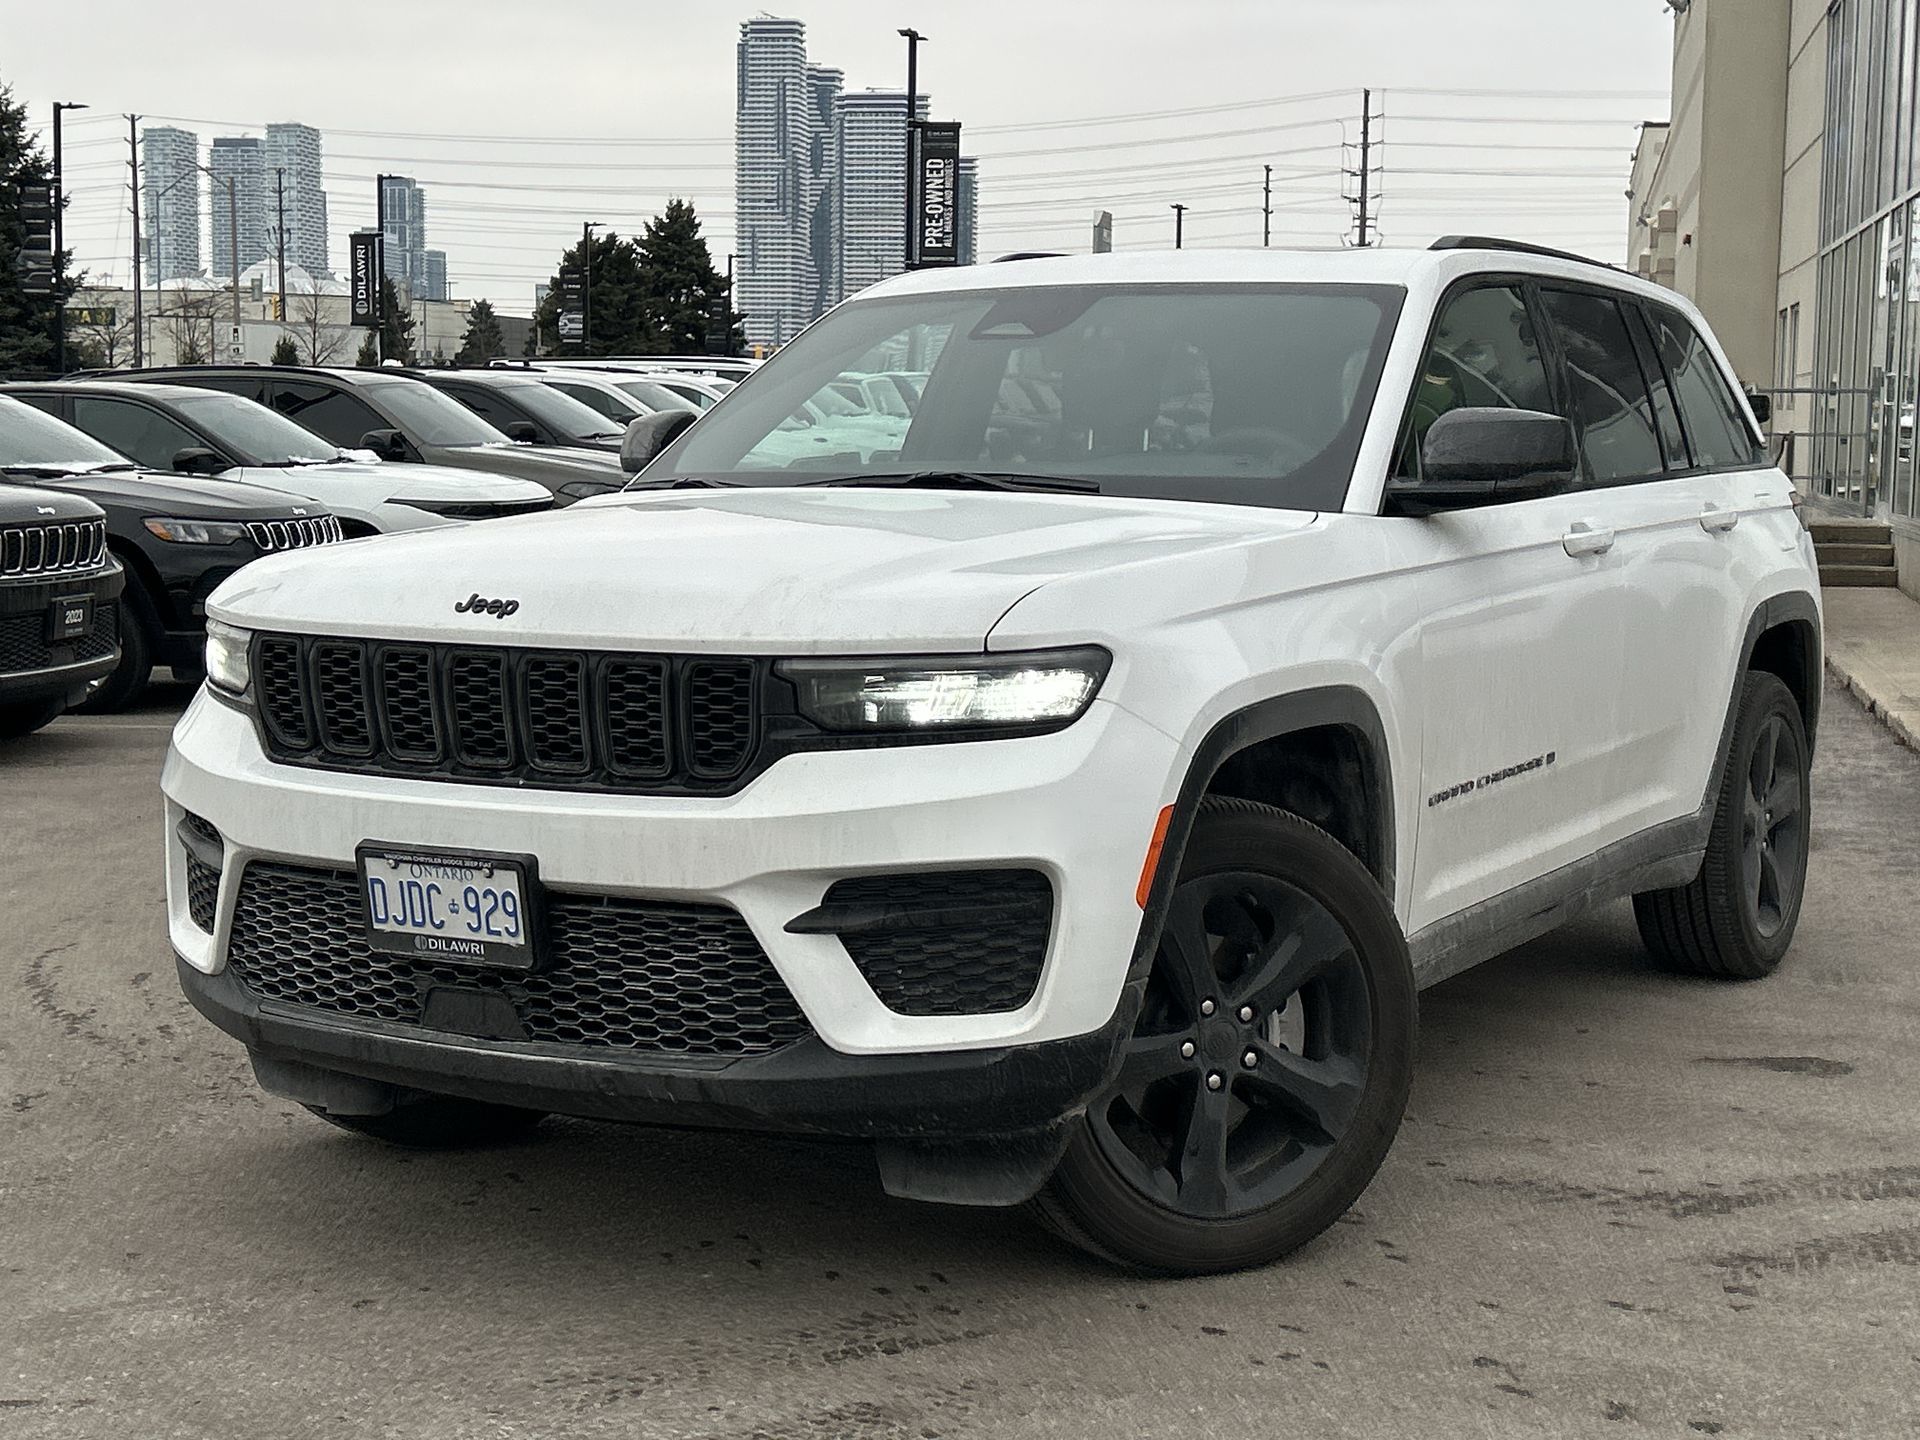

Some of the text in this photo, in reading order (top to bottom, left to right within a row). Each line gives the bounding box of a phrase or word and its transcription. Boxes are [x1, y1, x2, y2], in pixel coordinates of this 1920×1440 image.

[924, 158, 945, 248] PRE-OWNED
[944, 189, 953, 206] AND
[943, 206, 953, 233] MAKES
[943, 232, 953, 248] ALL
[356, 244, 367, 299] DILAWRI
[454, 593, 520, 619] Jeep
[65, 609, 83, 624] 2023
[412, 855, 442, 865] CHRYSLER
[410, 863, 474, 882] ONTARIO
[369, 877, 520, 938] DJDC 929
[428, 938, 485, 955] DILAWRI
